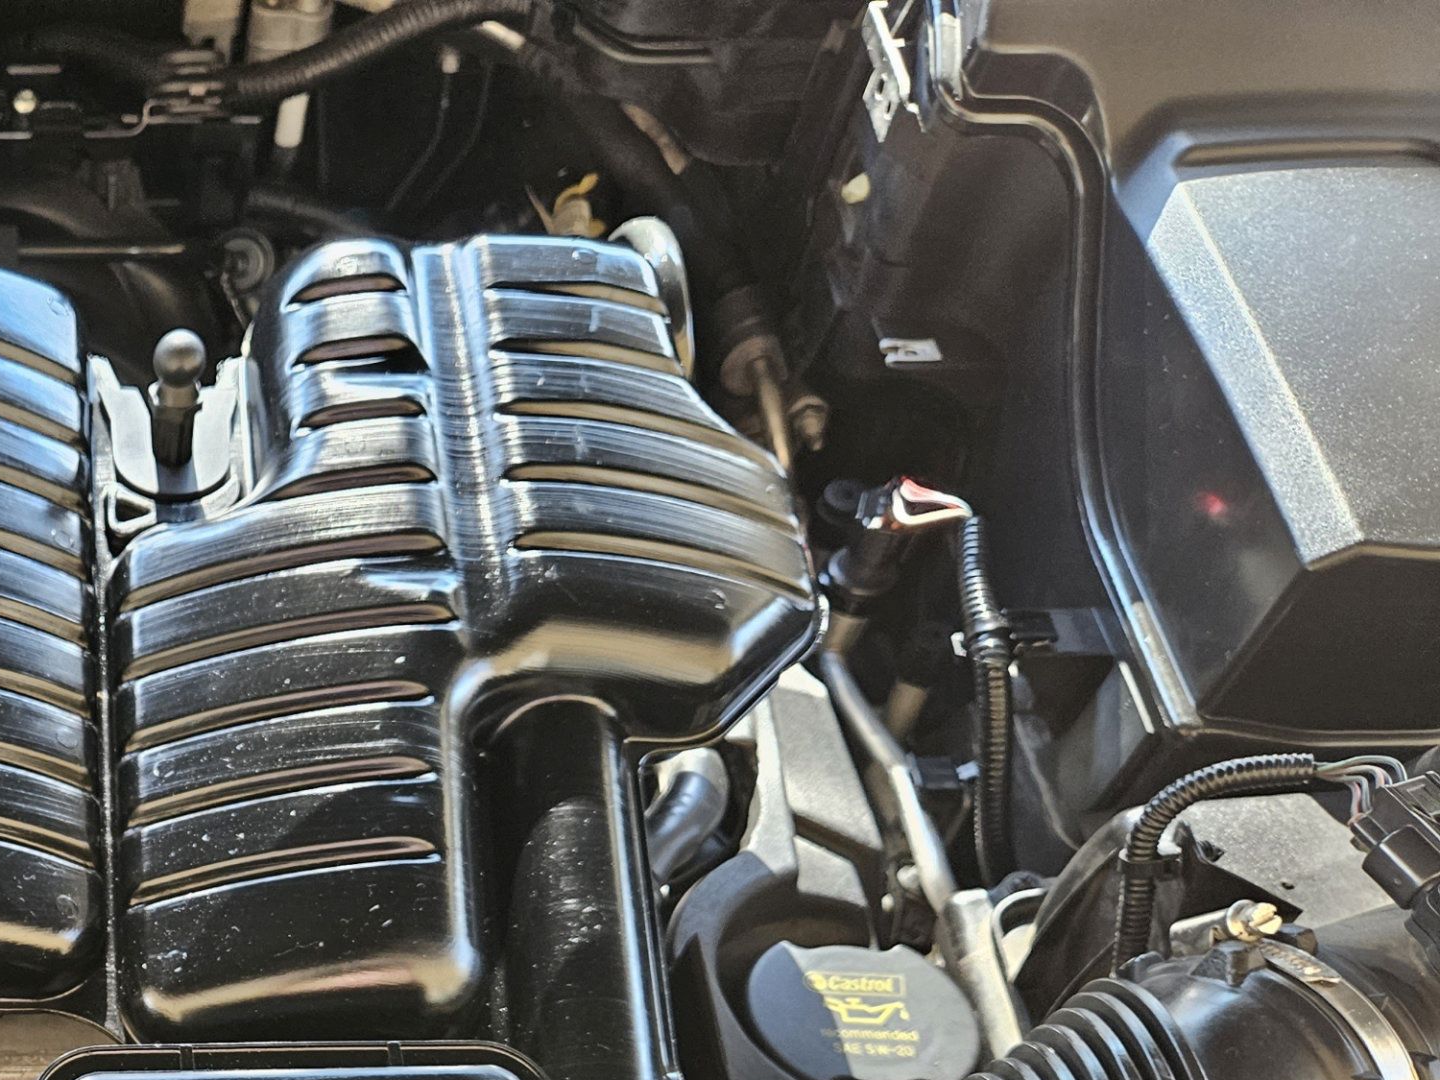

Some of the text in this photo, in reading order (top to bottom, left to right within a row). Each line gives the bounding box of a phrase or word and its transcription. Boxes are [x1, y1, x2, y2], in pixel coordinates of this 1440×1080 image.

[827, 976, 894, 993] Castrol
[821, 1029, 919, 1041] recommended
[832, 1042, 915, 1057] SAE 5W-20
